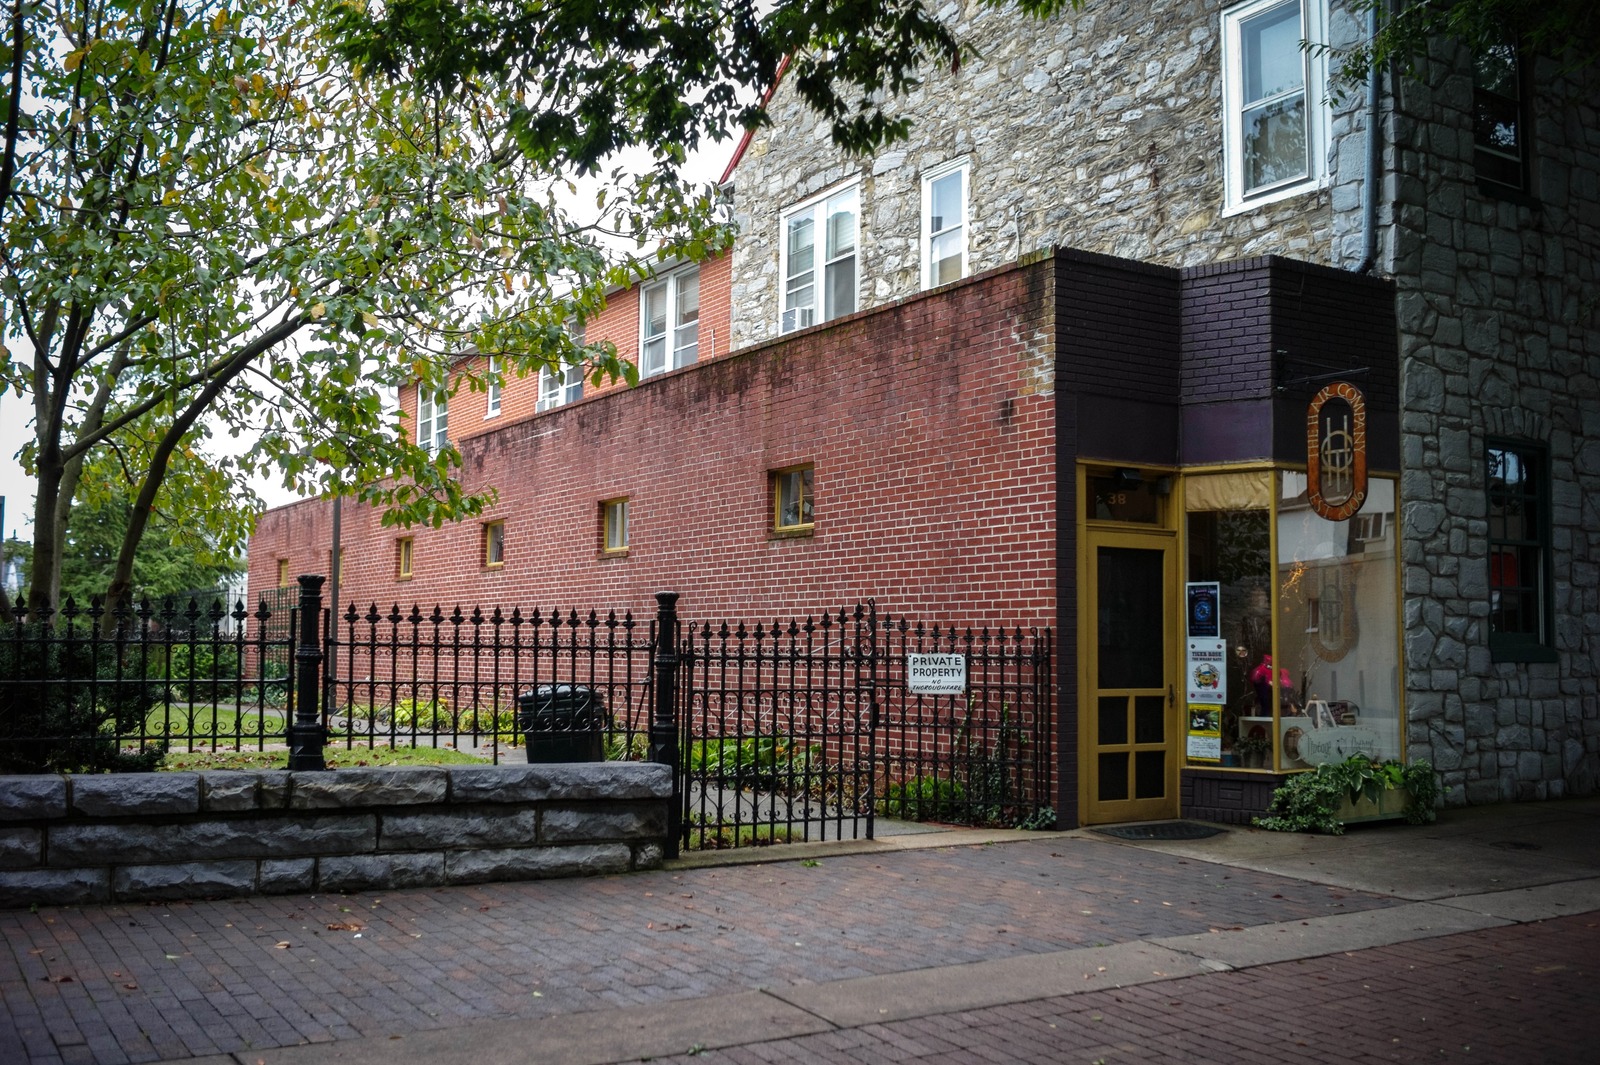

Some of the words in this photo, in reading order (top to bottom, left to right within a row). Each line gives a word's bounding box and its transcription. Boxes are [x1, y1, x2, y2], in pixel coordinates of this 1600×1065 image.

[1307, 386, 1335, 426] HAIR
[1337, 383, 1366, 454] COMPANY
[1307, 429, 1319, 463] THE
[1108, 492, 1126, 505] 38
[1338, 488, 1365, 520] 2006
[912, 657, 961, 665] PRIVATE
[912, 667, 962, 676] PROPERTY
